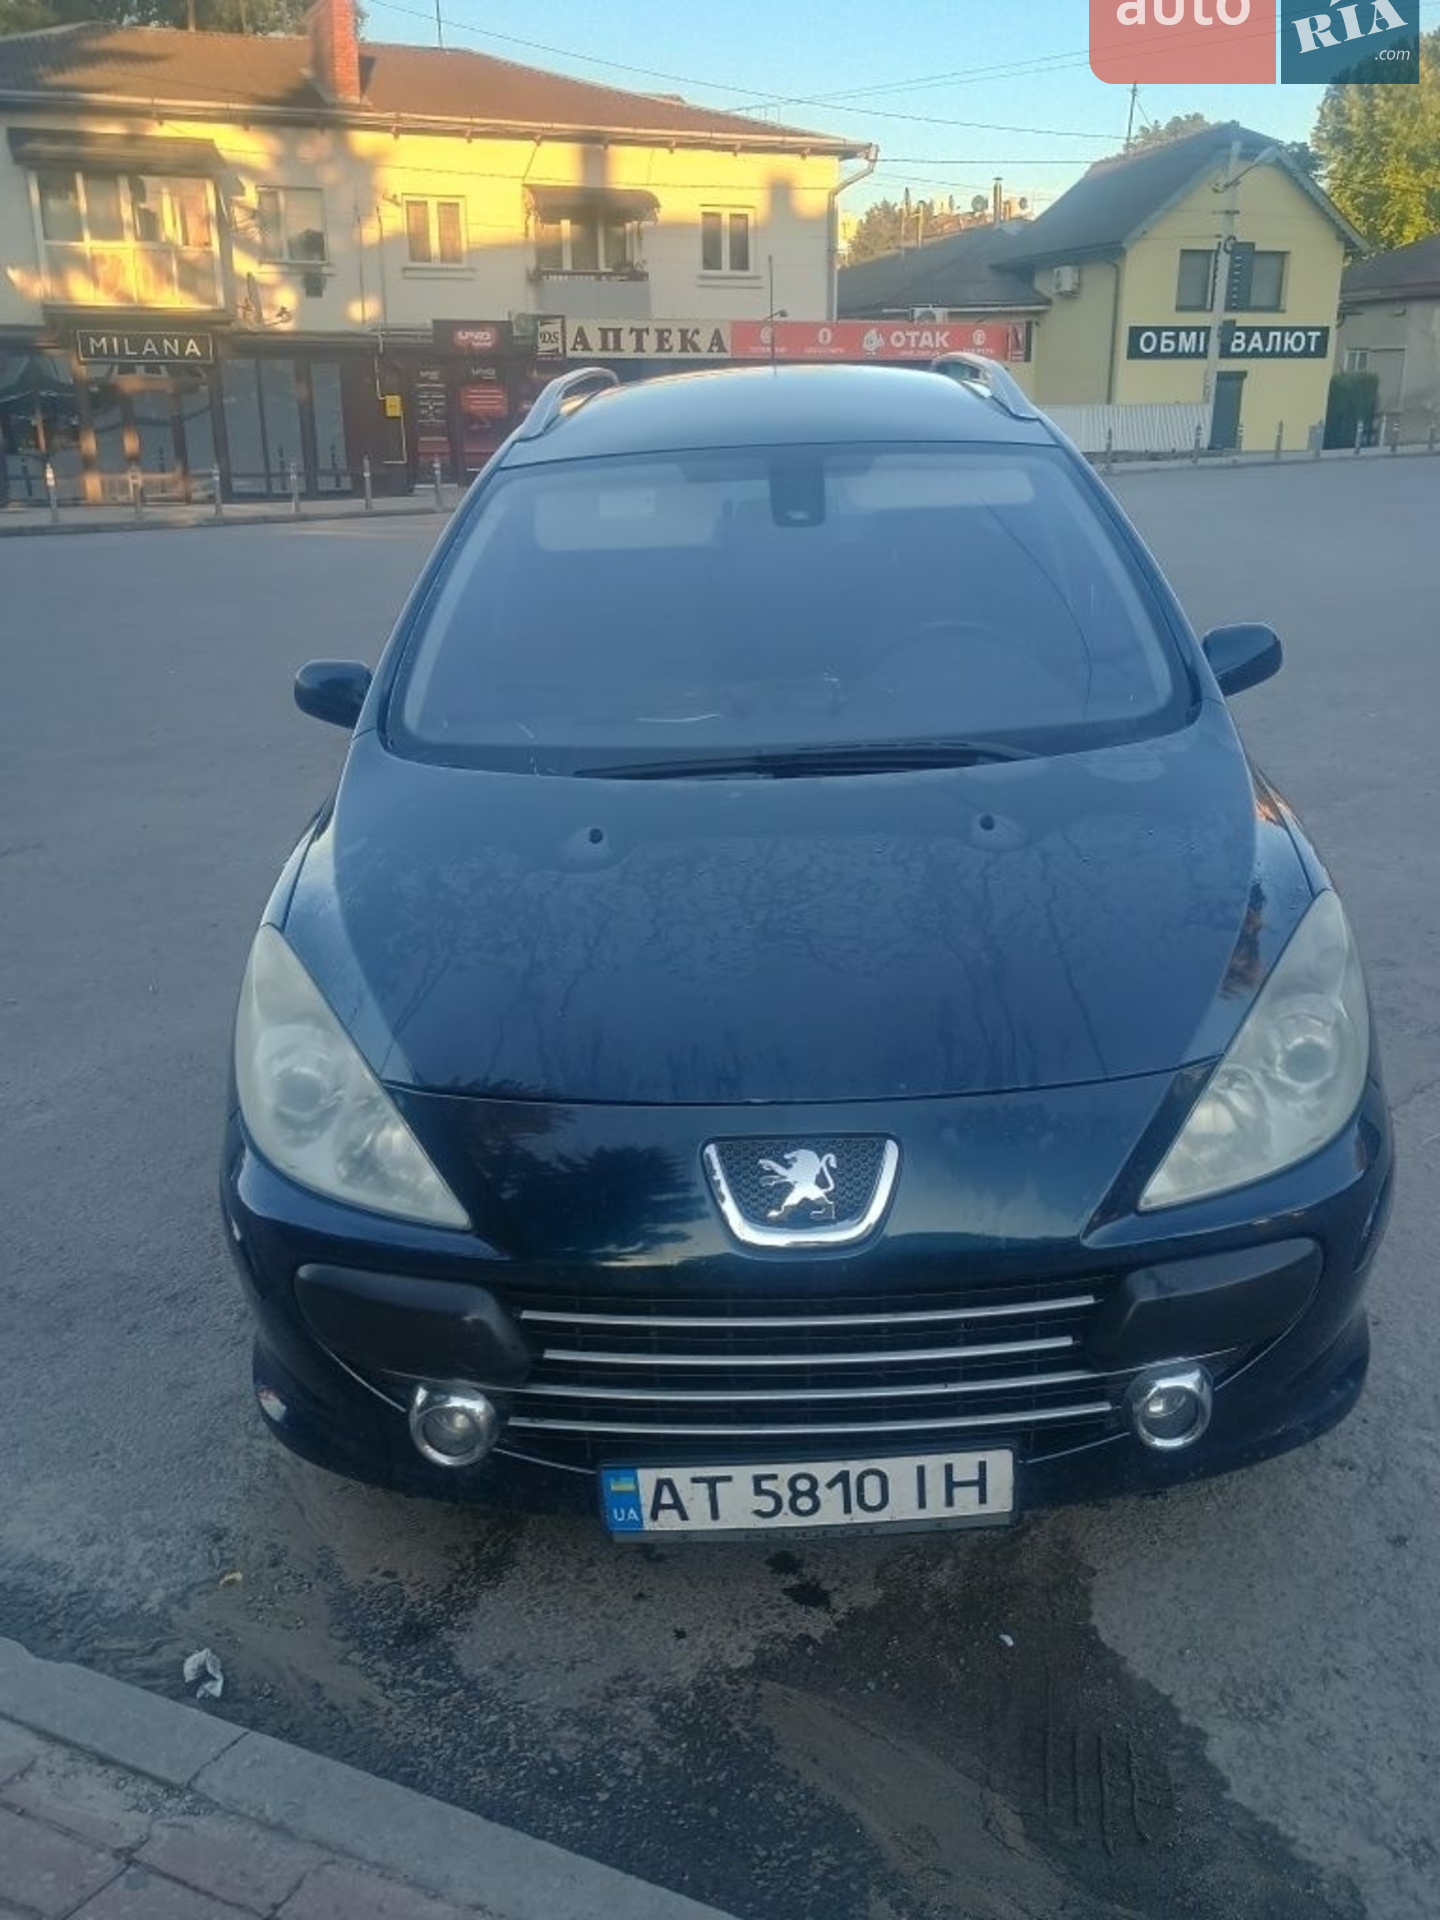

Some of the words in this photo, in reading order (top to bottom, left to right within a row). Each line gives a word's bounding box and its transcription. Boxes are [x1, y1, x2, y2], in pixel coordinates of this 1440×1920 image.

[89, 336, 202, 357] MILANA
[569, 325, 729, 354] АПТЕКА
[890, 331, 950, 348] ОТАК
[1139, 331, 1209, 353] ОБМІ
[1231, 331, 1321, 353] ВАЛЮТ
[649, 1475, 733, 1522] AT
[751, 1467, 889, 1519] 5810
[916, 1460, 988, 1511] IH
[613, 1511, 638, 1522] UA
